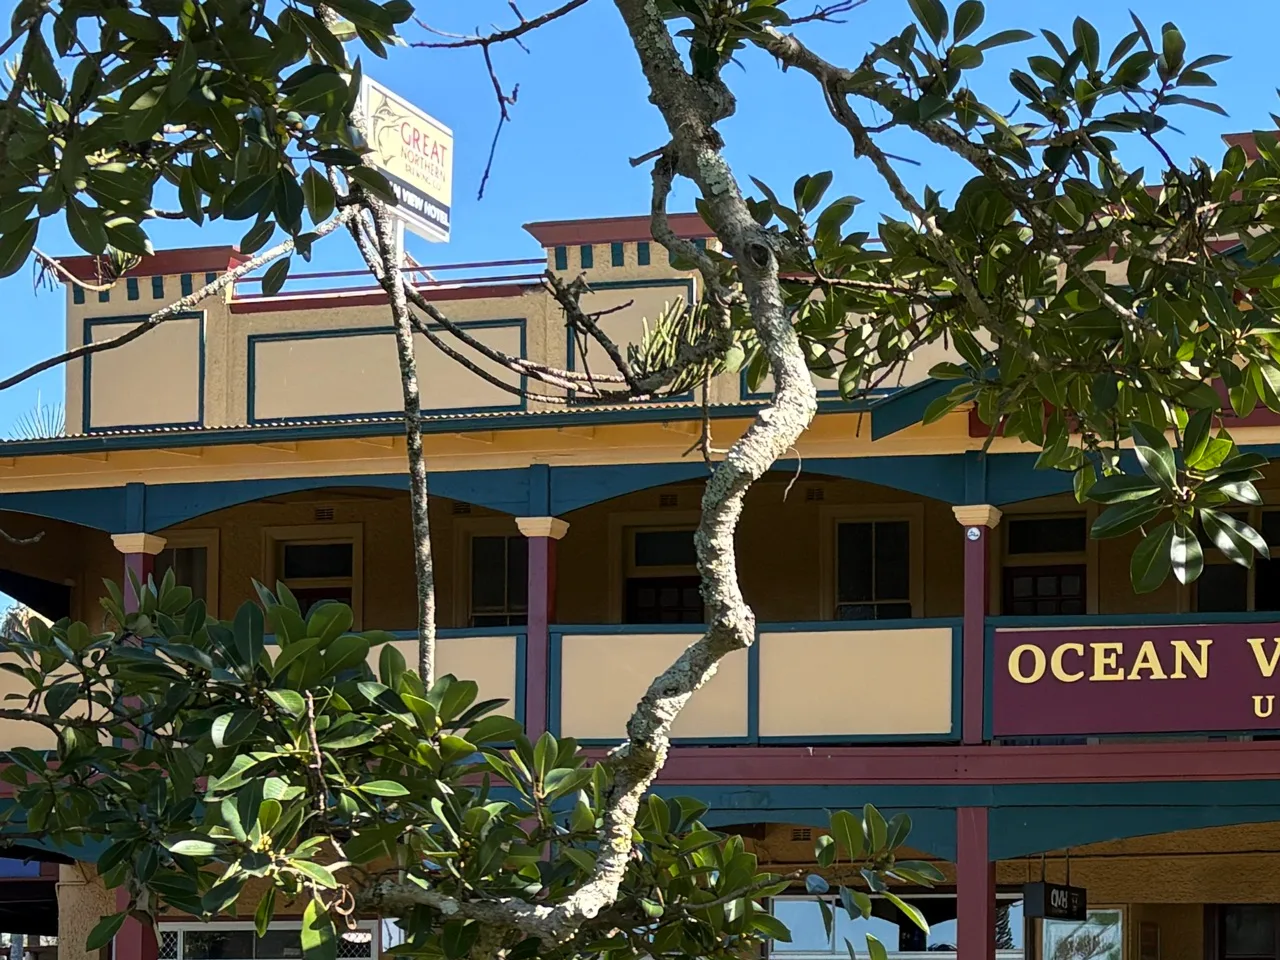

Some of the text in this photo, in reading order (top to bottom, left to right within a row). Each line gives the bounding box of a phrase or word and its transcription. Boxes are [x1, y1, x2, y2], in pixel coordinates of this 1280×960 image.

[401, 122, 447, 167] GREAT
[401, 146, 446, 182] NORTHERN
[402, 189, 424, 211] VIEW
[424, 200, 449, 224] HOTEL
[1008, 639, 1213, 684] OCEAN
